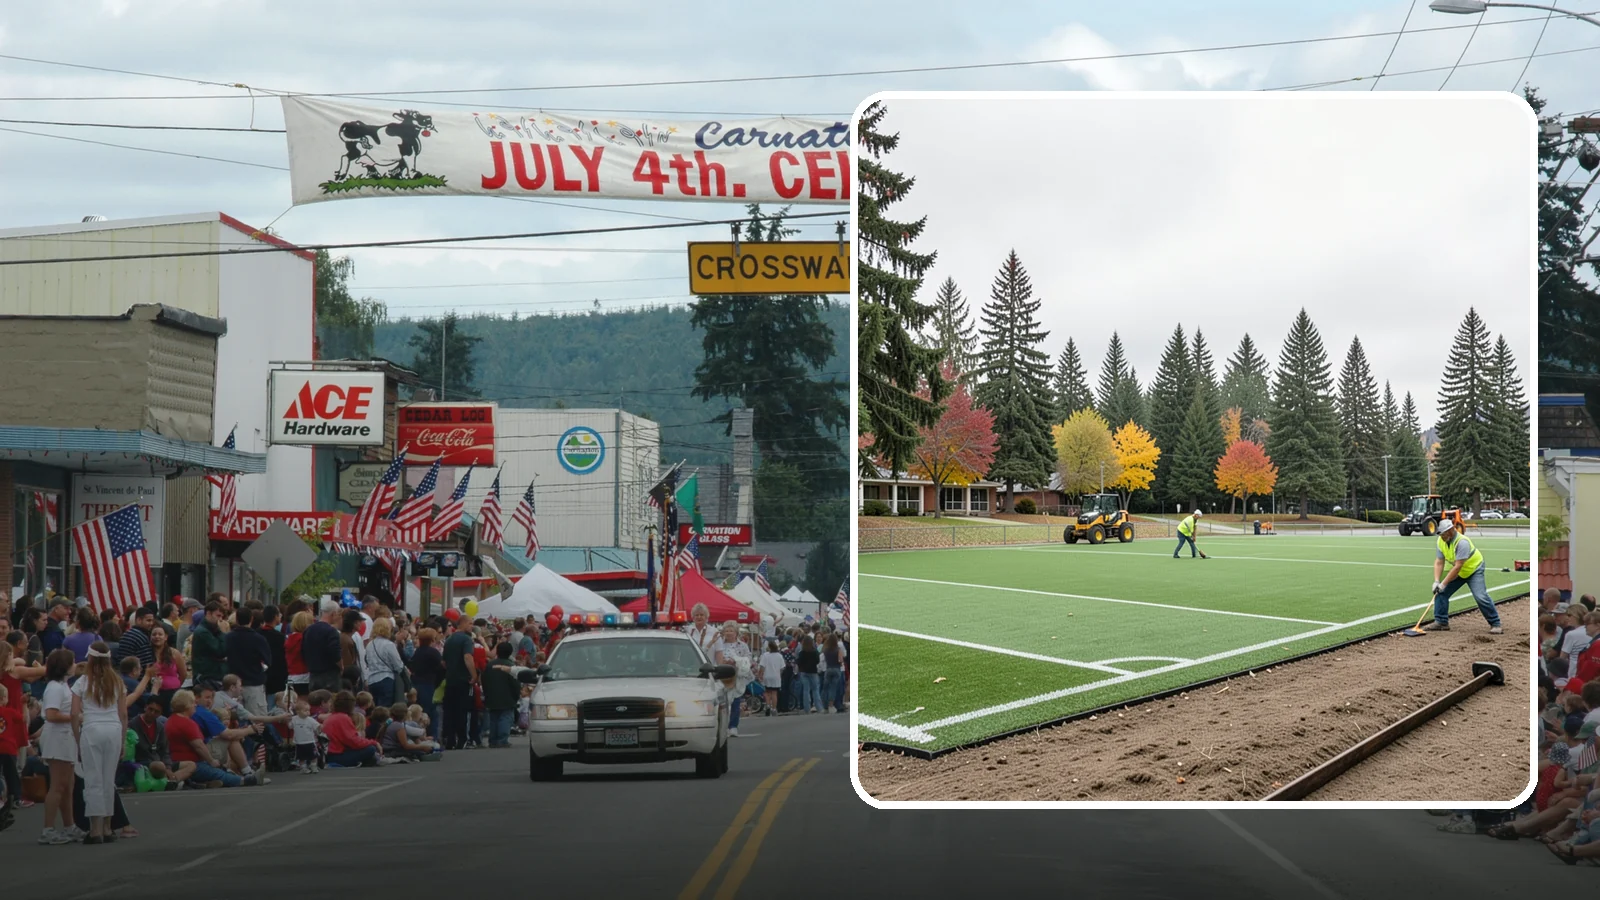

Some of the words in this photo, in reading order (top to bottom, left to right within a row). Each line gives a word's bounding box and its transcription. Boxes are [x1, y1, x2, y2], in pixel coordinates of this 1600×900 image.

[695, 121, 850, 149] Carnat
[481, 141, 605, 192] JULY
[633, 150, 746, 197] 4th.
[697, 254, 850, 280] CROSSWA
[283, 380, 373, 420] ACE
[406, 410, 452, 422] CEDAR
[461, 410, 484, 422] LOG
[284, 421, 370, 436] Hardware
[416, 428, 476, 446] Coca-Cola
[354, 467, 386, 480] Simpl
[95, 485, 124, 494] Vincent
[126, 486, 135, 494] de
[138, 486, 155, 495] Paul
[688, 526, 741, 535] CRNATION
[699, 535, 730, 543] GLASS
